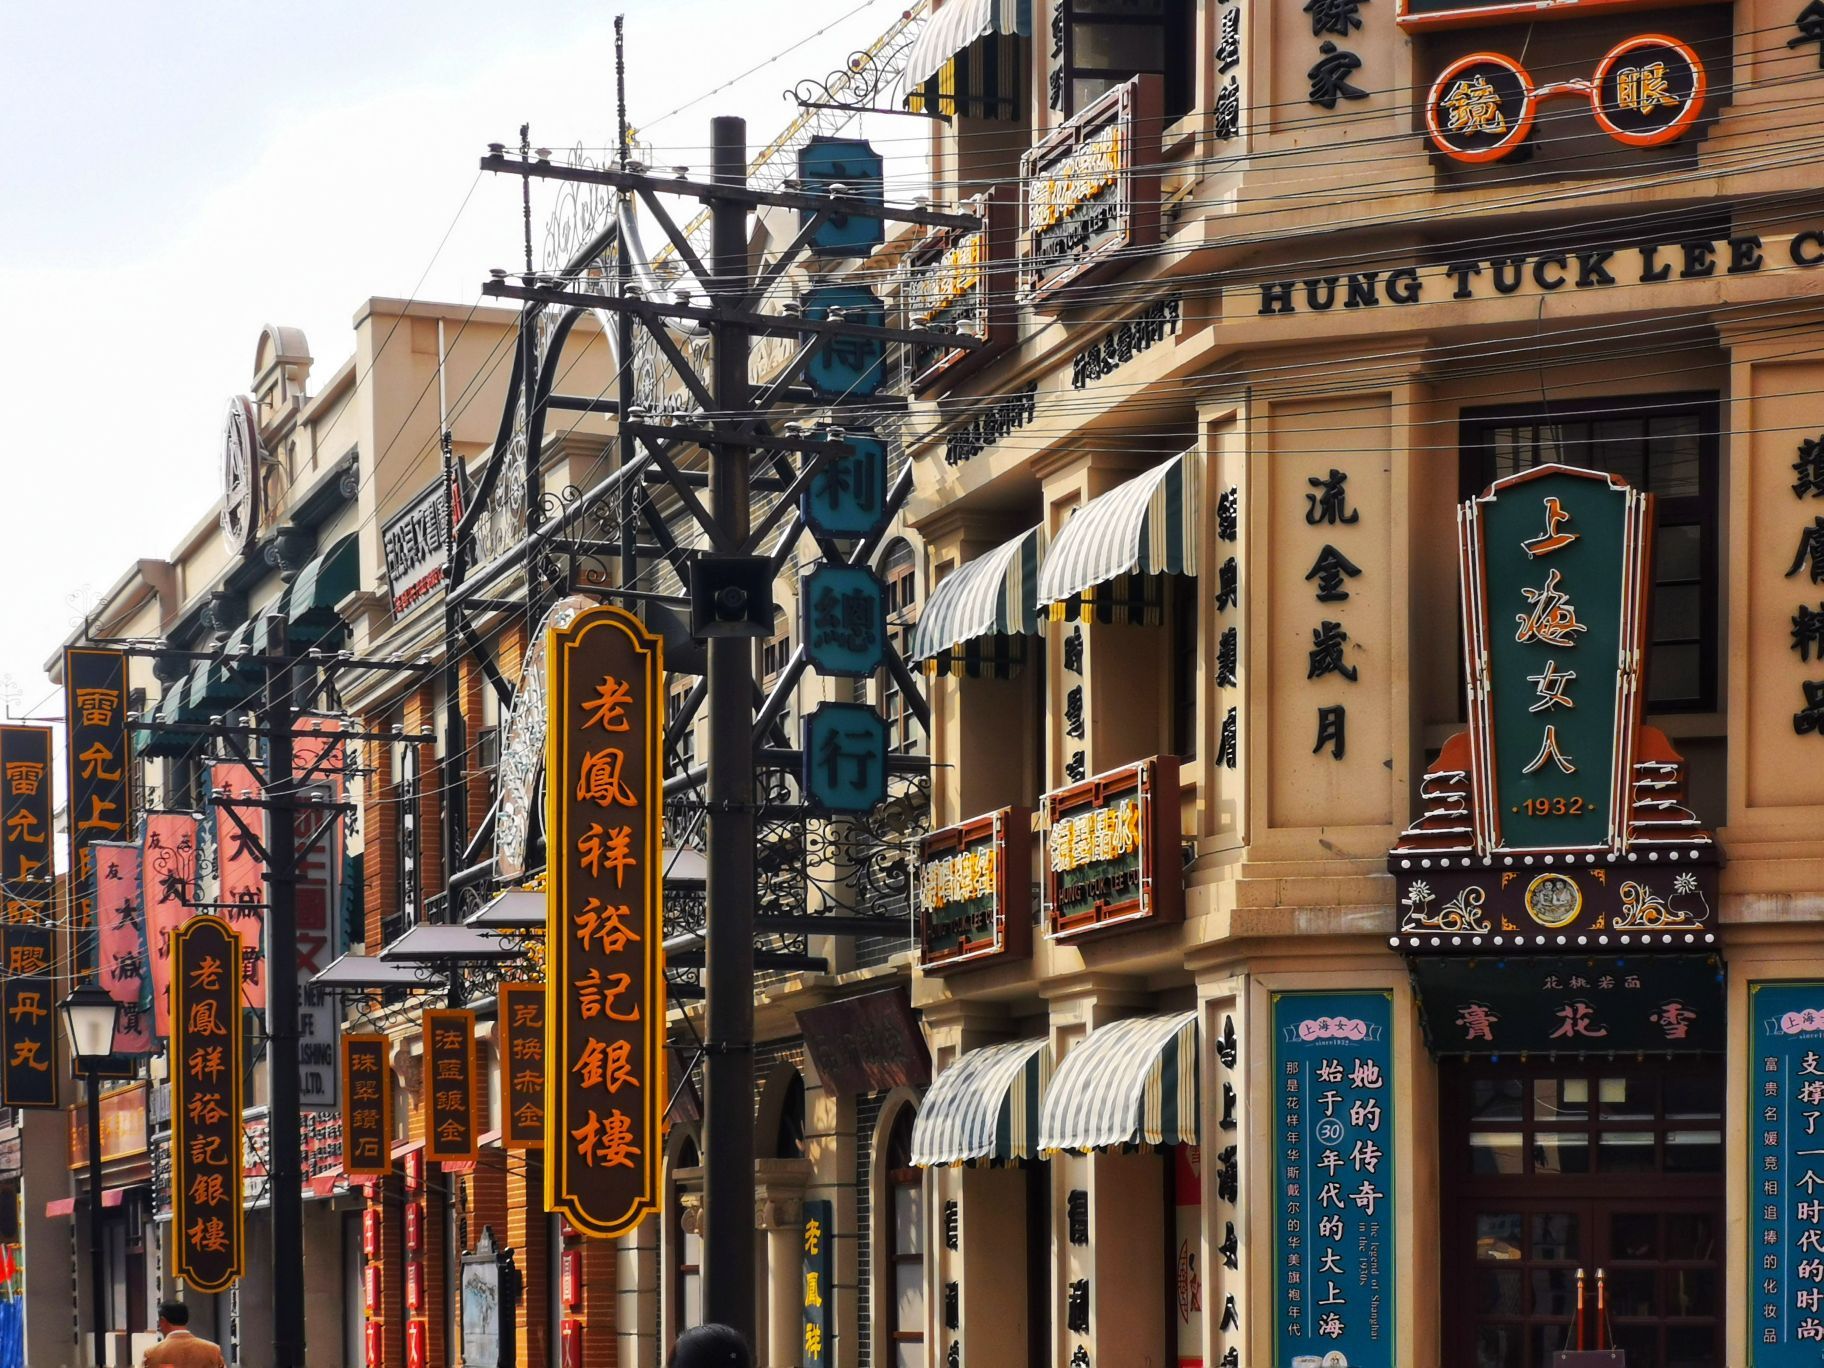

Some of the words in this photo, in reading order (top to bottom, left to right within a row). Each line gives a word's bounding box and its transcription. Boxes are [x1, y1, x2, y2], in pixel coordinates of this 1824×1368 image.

[1257, 267, 1423, 315] HUNG
[1446, 250, 1615, 300] TUCK
[1638, 234, 1764, 283] LEE
[1305, 468, 1362, 762] 流金歲月
[1516, 496, 1588, 776] 上海女人
[1522, 797, 1583, 817] 1932
[571, 675, 642, 1169] 老鳳祥裕記銀樓
[299, 1043, 332, 1066] ISHING
[1304, 1019, 1364, 1037] 上海女人
[1786, 1012, 1824, 1029] 上海
[186, 955, 230, 1252] 老鳳祥裕記銀樓
[1347, 1058, 1384, 1216] 她的传奇
[1286, 1062, 1301, 1337] 那是花样年华斯戴尔的华美旗袍年代
[1371, 1241, 1380, 1276] legend
[1763, 1057, 1778, 1343] 富贵名媛竞相追捧的化妆品
[1796, 1051, 1824, 1341] 支撑了一个时代的时尚
[805, 1218, 822, 1360] 老鳳祥
